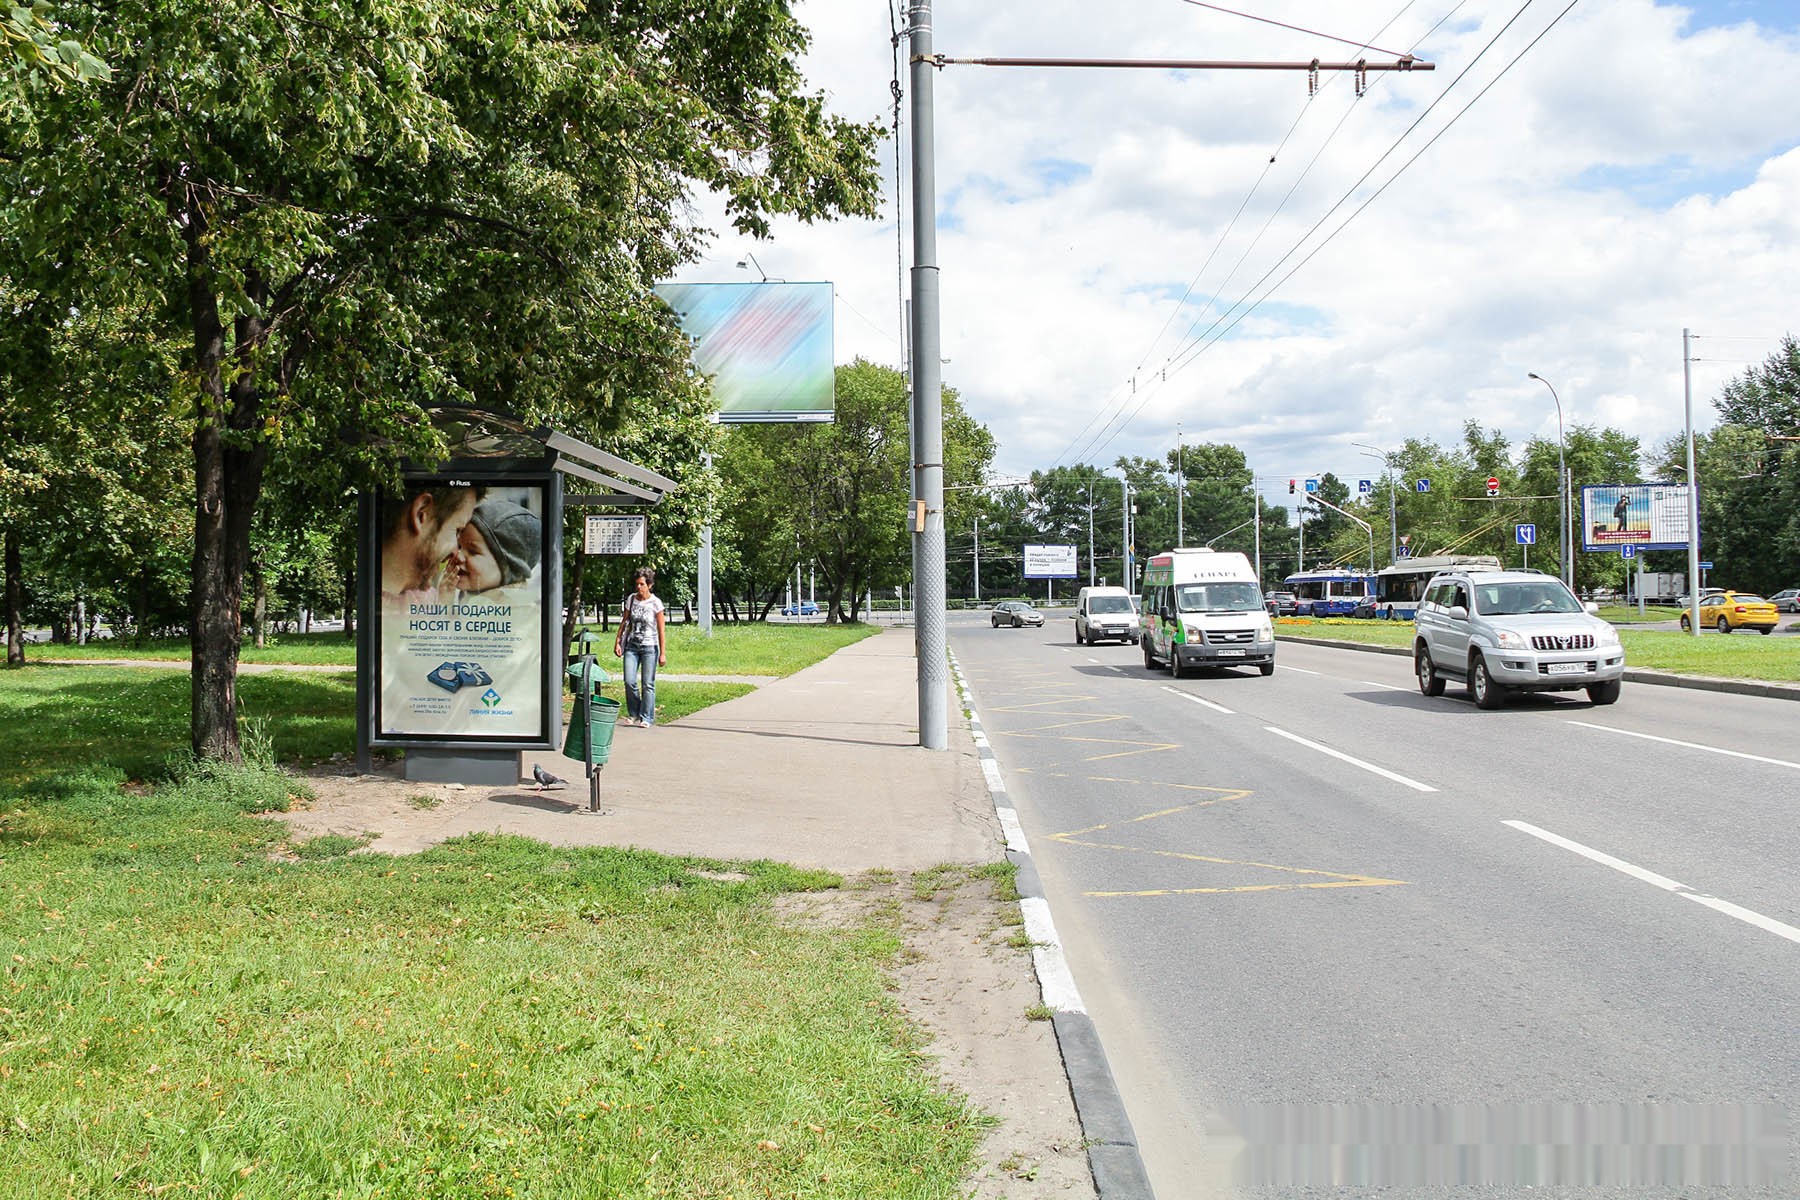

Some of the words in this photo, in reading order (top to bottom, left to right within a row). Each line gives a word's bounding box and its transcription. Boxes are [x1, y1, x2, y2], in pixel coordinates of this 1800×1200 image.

[410, 604, 448, 616] ВАШИ
[451, 604, 511, 618] ПОДАРКИ
[409, 620, 450, 632] НОСЯТ
[454, 620, 462, 632] В
[465, 621, 512, 634] СЕРДЦЕ
